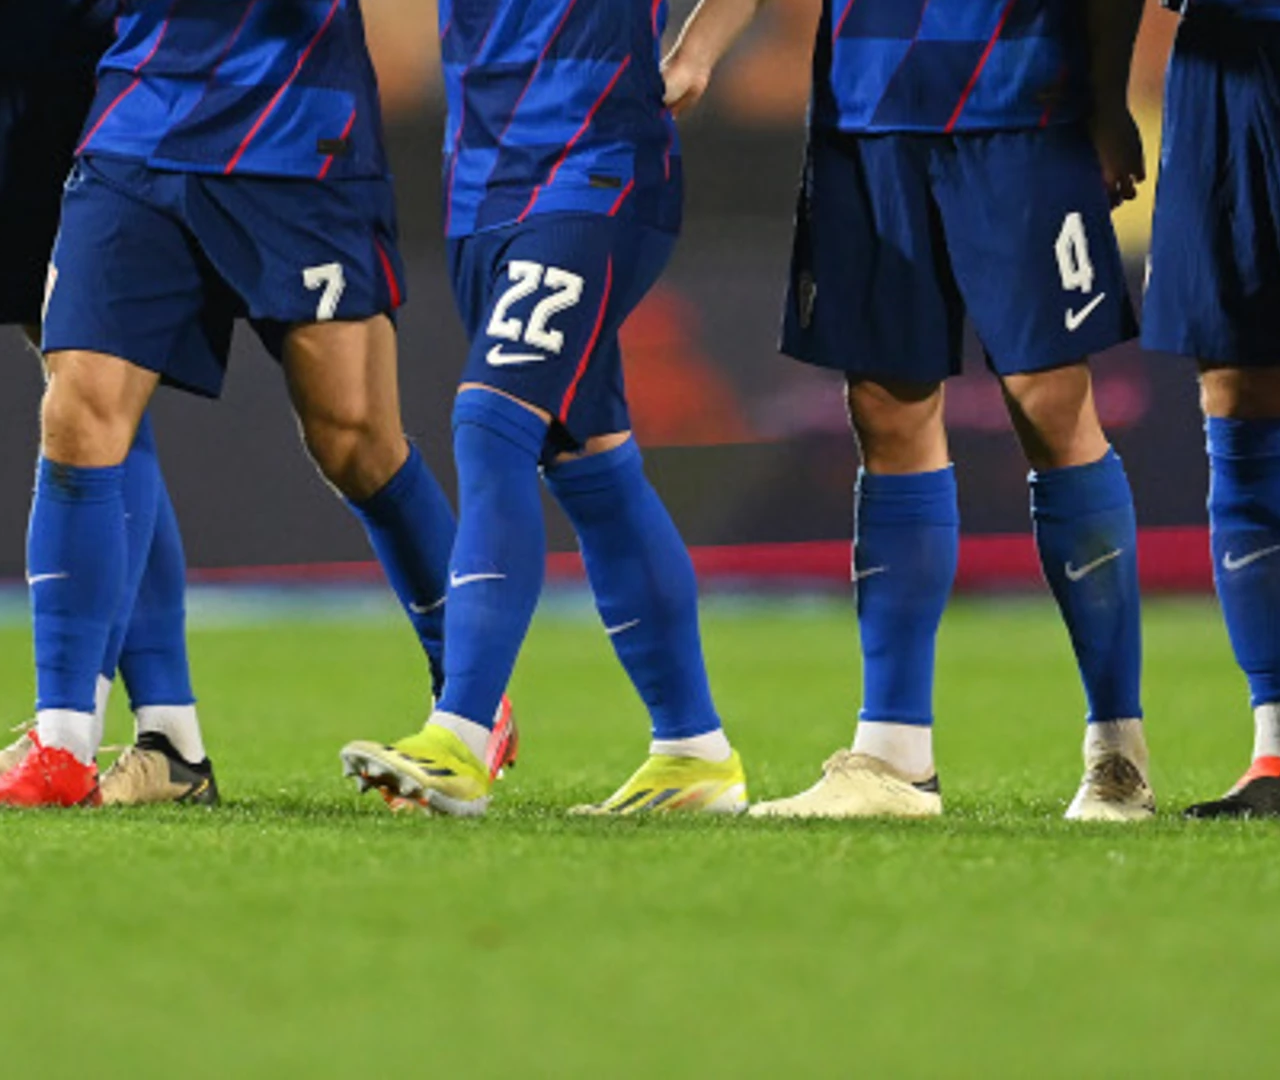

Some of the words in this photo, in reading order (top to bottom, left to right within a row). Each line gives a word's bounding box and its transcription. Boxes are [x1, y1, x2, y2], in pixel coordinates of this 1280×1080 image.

[301, 262, 346, 320] 7
[1054, 211, 1096, 294] 4
[486, 258, 584, 354] 22
